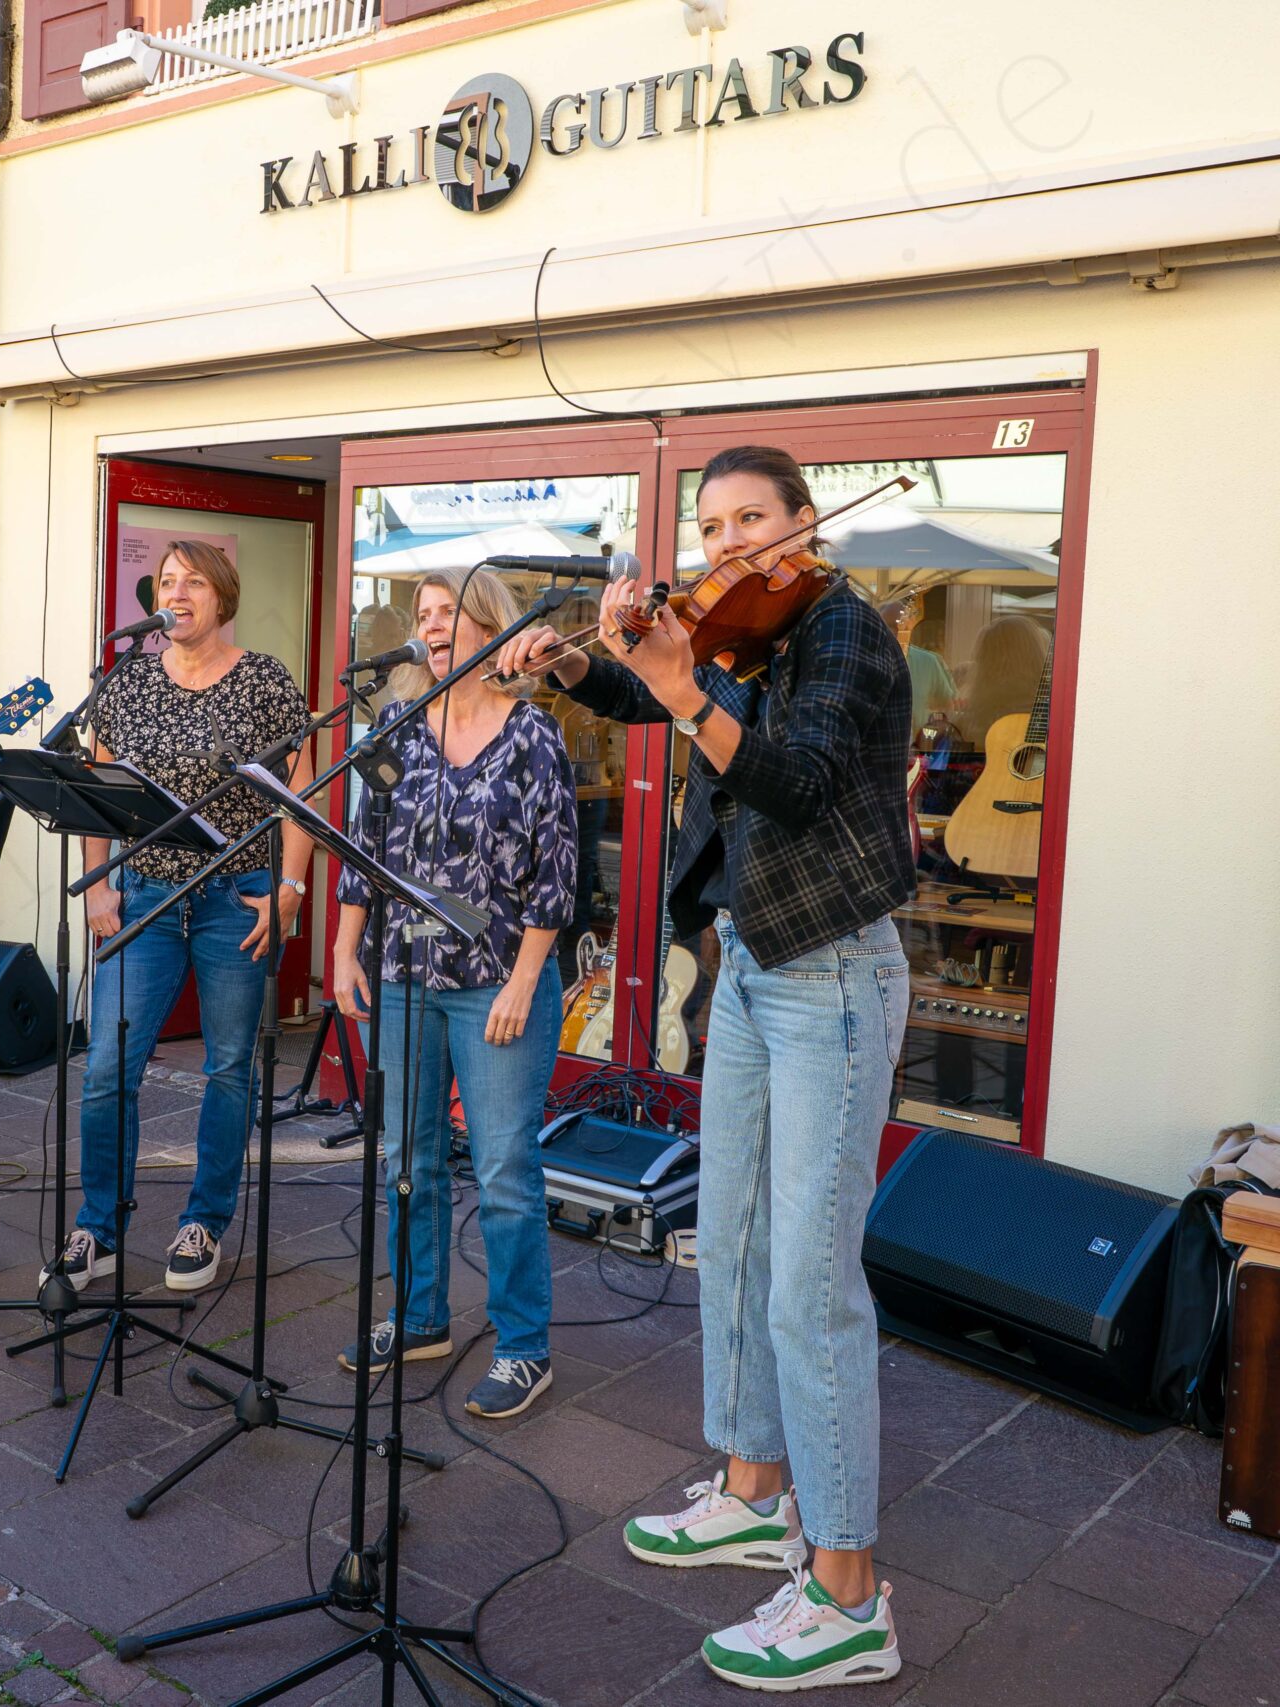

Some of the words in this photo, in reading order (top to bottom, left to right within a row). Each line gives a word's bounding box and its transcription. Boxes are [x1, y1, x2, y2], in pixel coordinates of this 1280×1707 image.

[260, 126, 431, 214] KALLI
[540, 31, 868, 157] GUITARS
[998, 421, 1031, 447] 13
[1090, 1238, 1110, 1255] EV
[1226, 1517, 1252, 1529] drums
